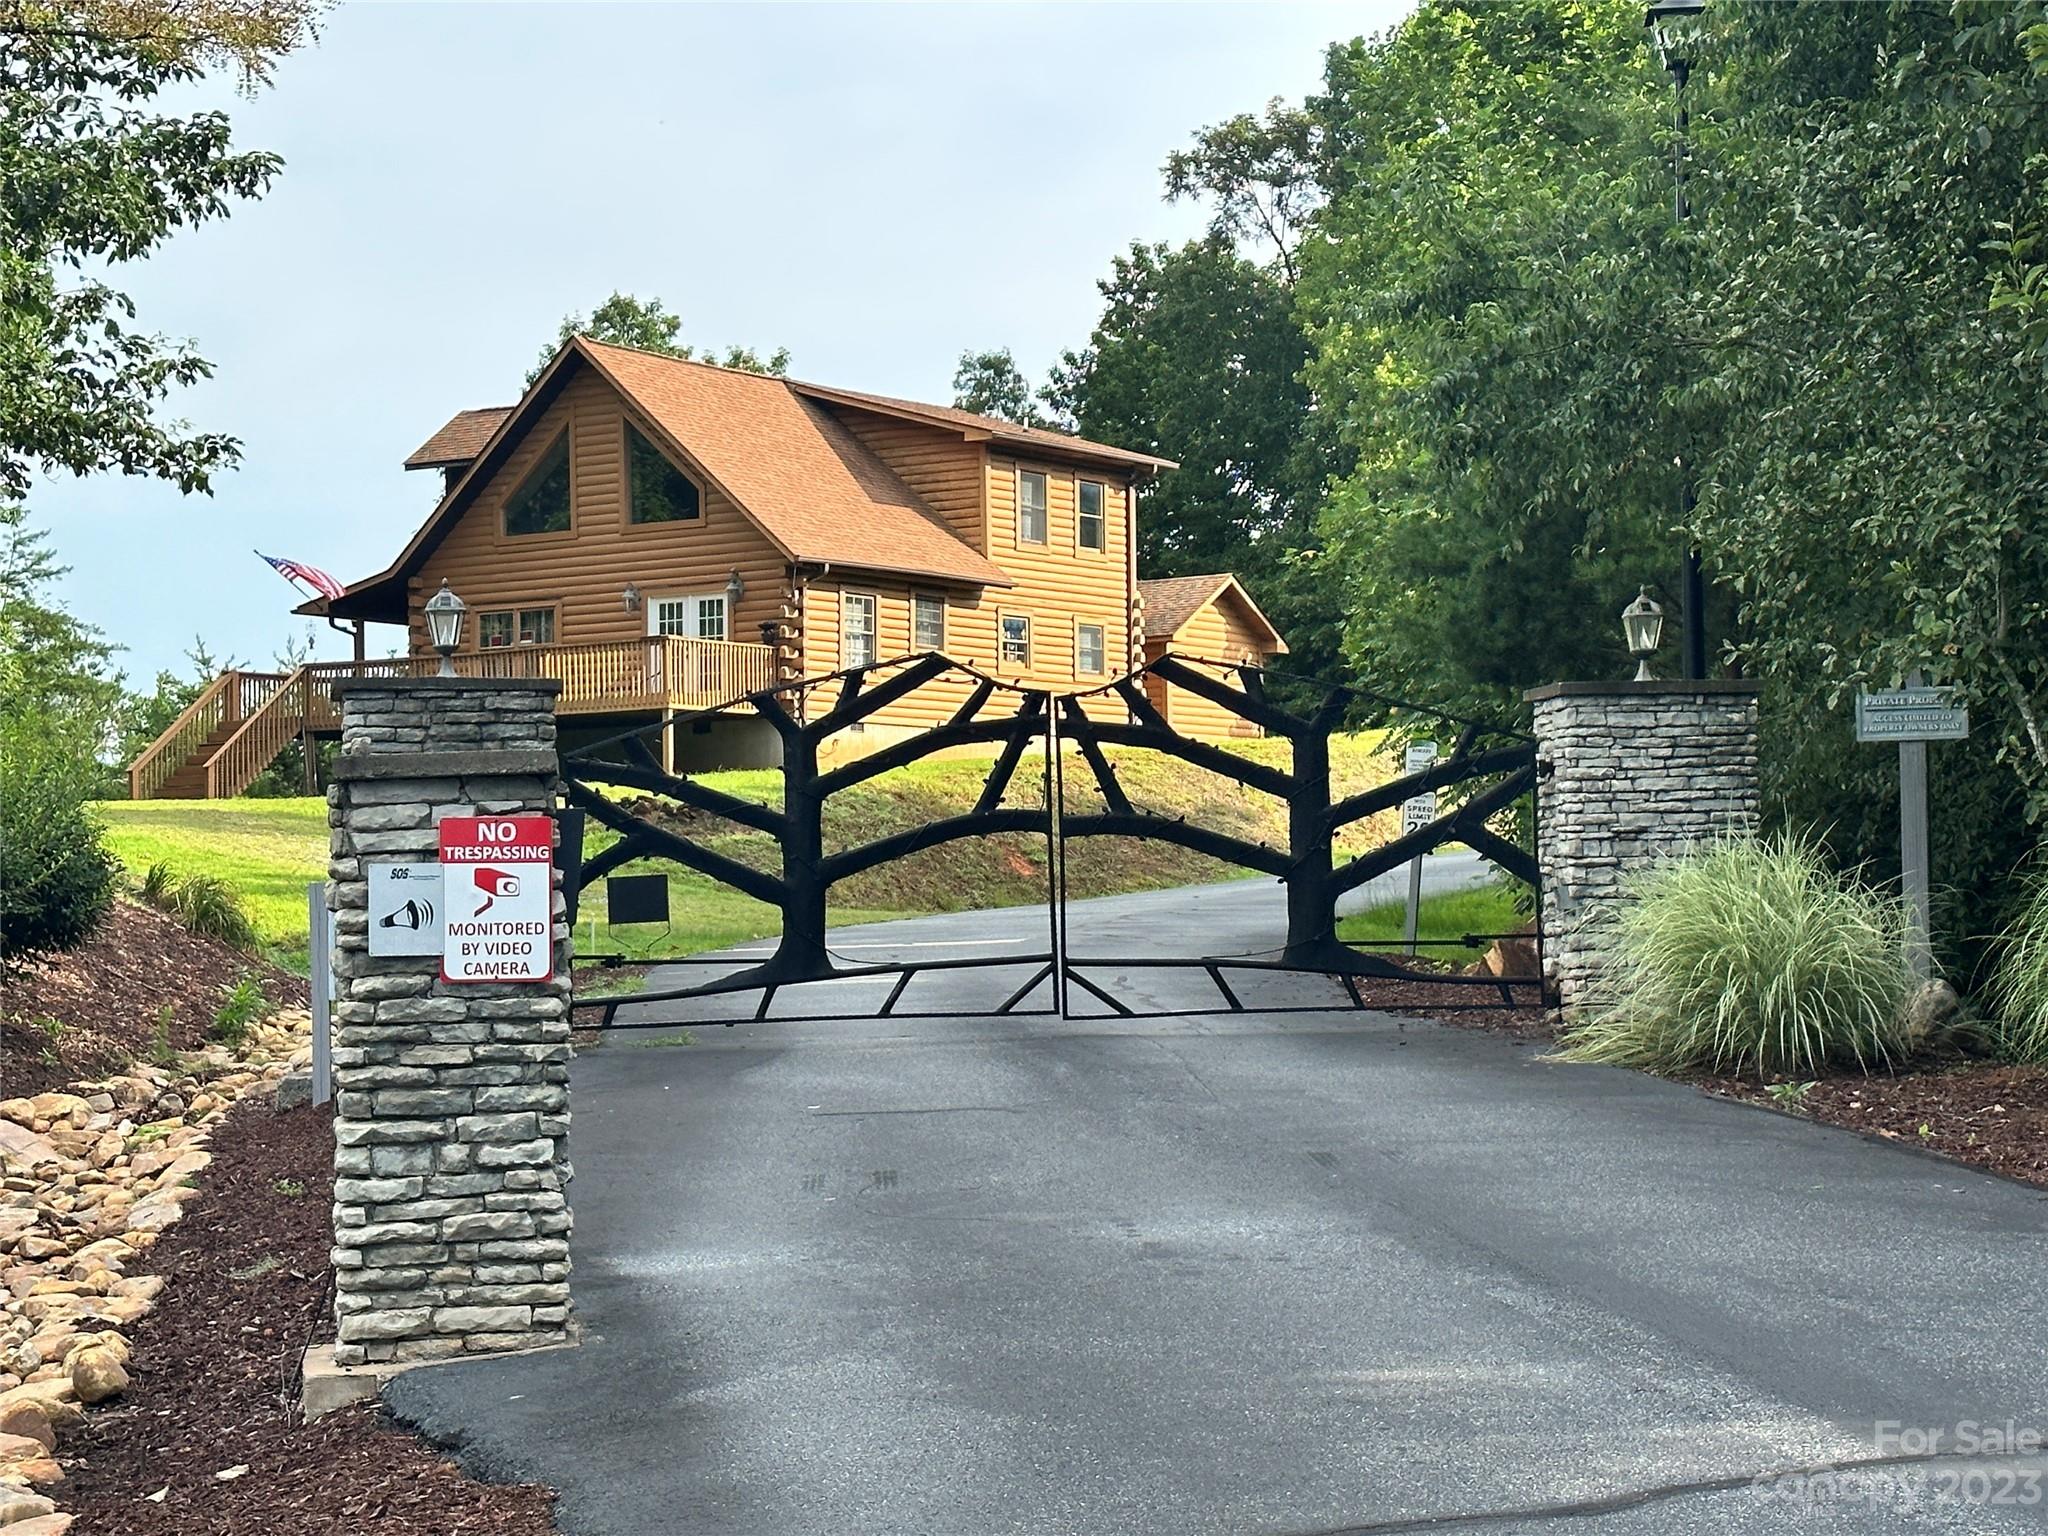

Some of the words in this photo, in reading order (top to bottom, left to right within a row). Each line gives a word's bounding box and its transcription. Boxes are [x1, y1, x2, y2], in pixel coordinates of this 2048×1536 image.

[1865, 695, 1906, 706] PRIVATE
[1874, 713, 1902, 723] ACCESS
[1864, 723, 1903, 732] PROPERTY
[1407, 805, 1433, 813] SPEED
[478, 823, 516, 842] NO
[1407, 821, 1429, 834] 2
[445, 846, 549, 860] TRESPASSING
[390, 868, 410, 879] SOS
[449, 922, 544, 936] MONITORED
[462, 943, 480, 956] BY
[484, 942, 532, 955] VIDEO
[464, 962, 530, 975] CAMERA
